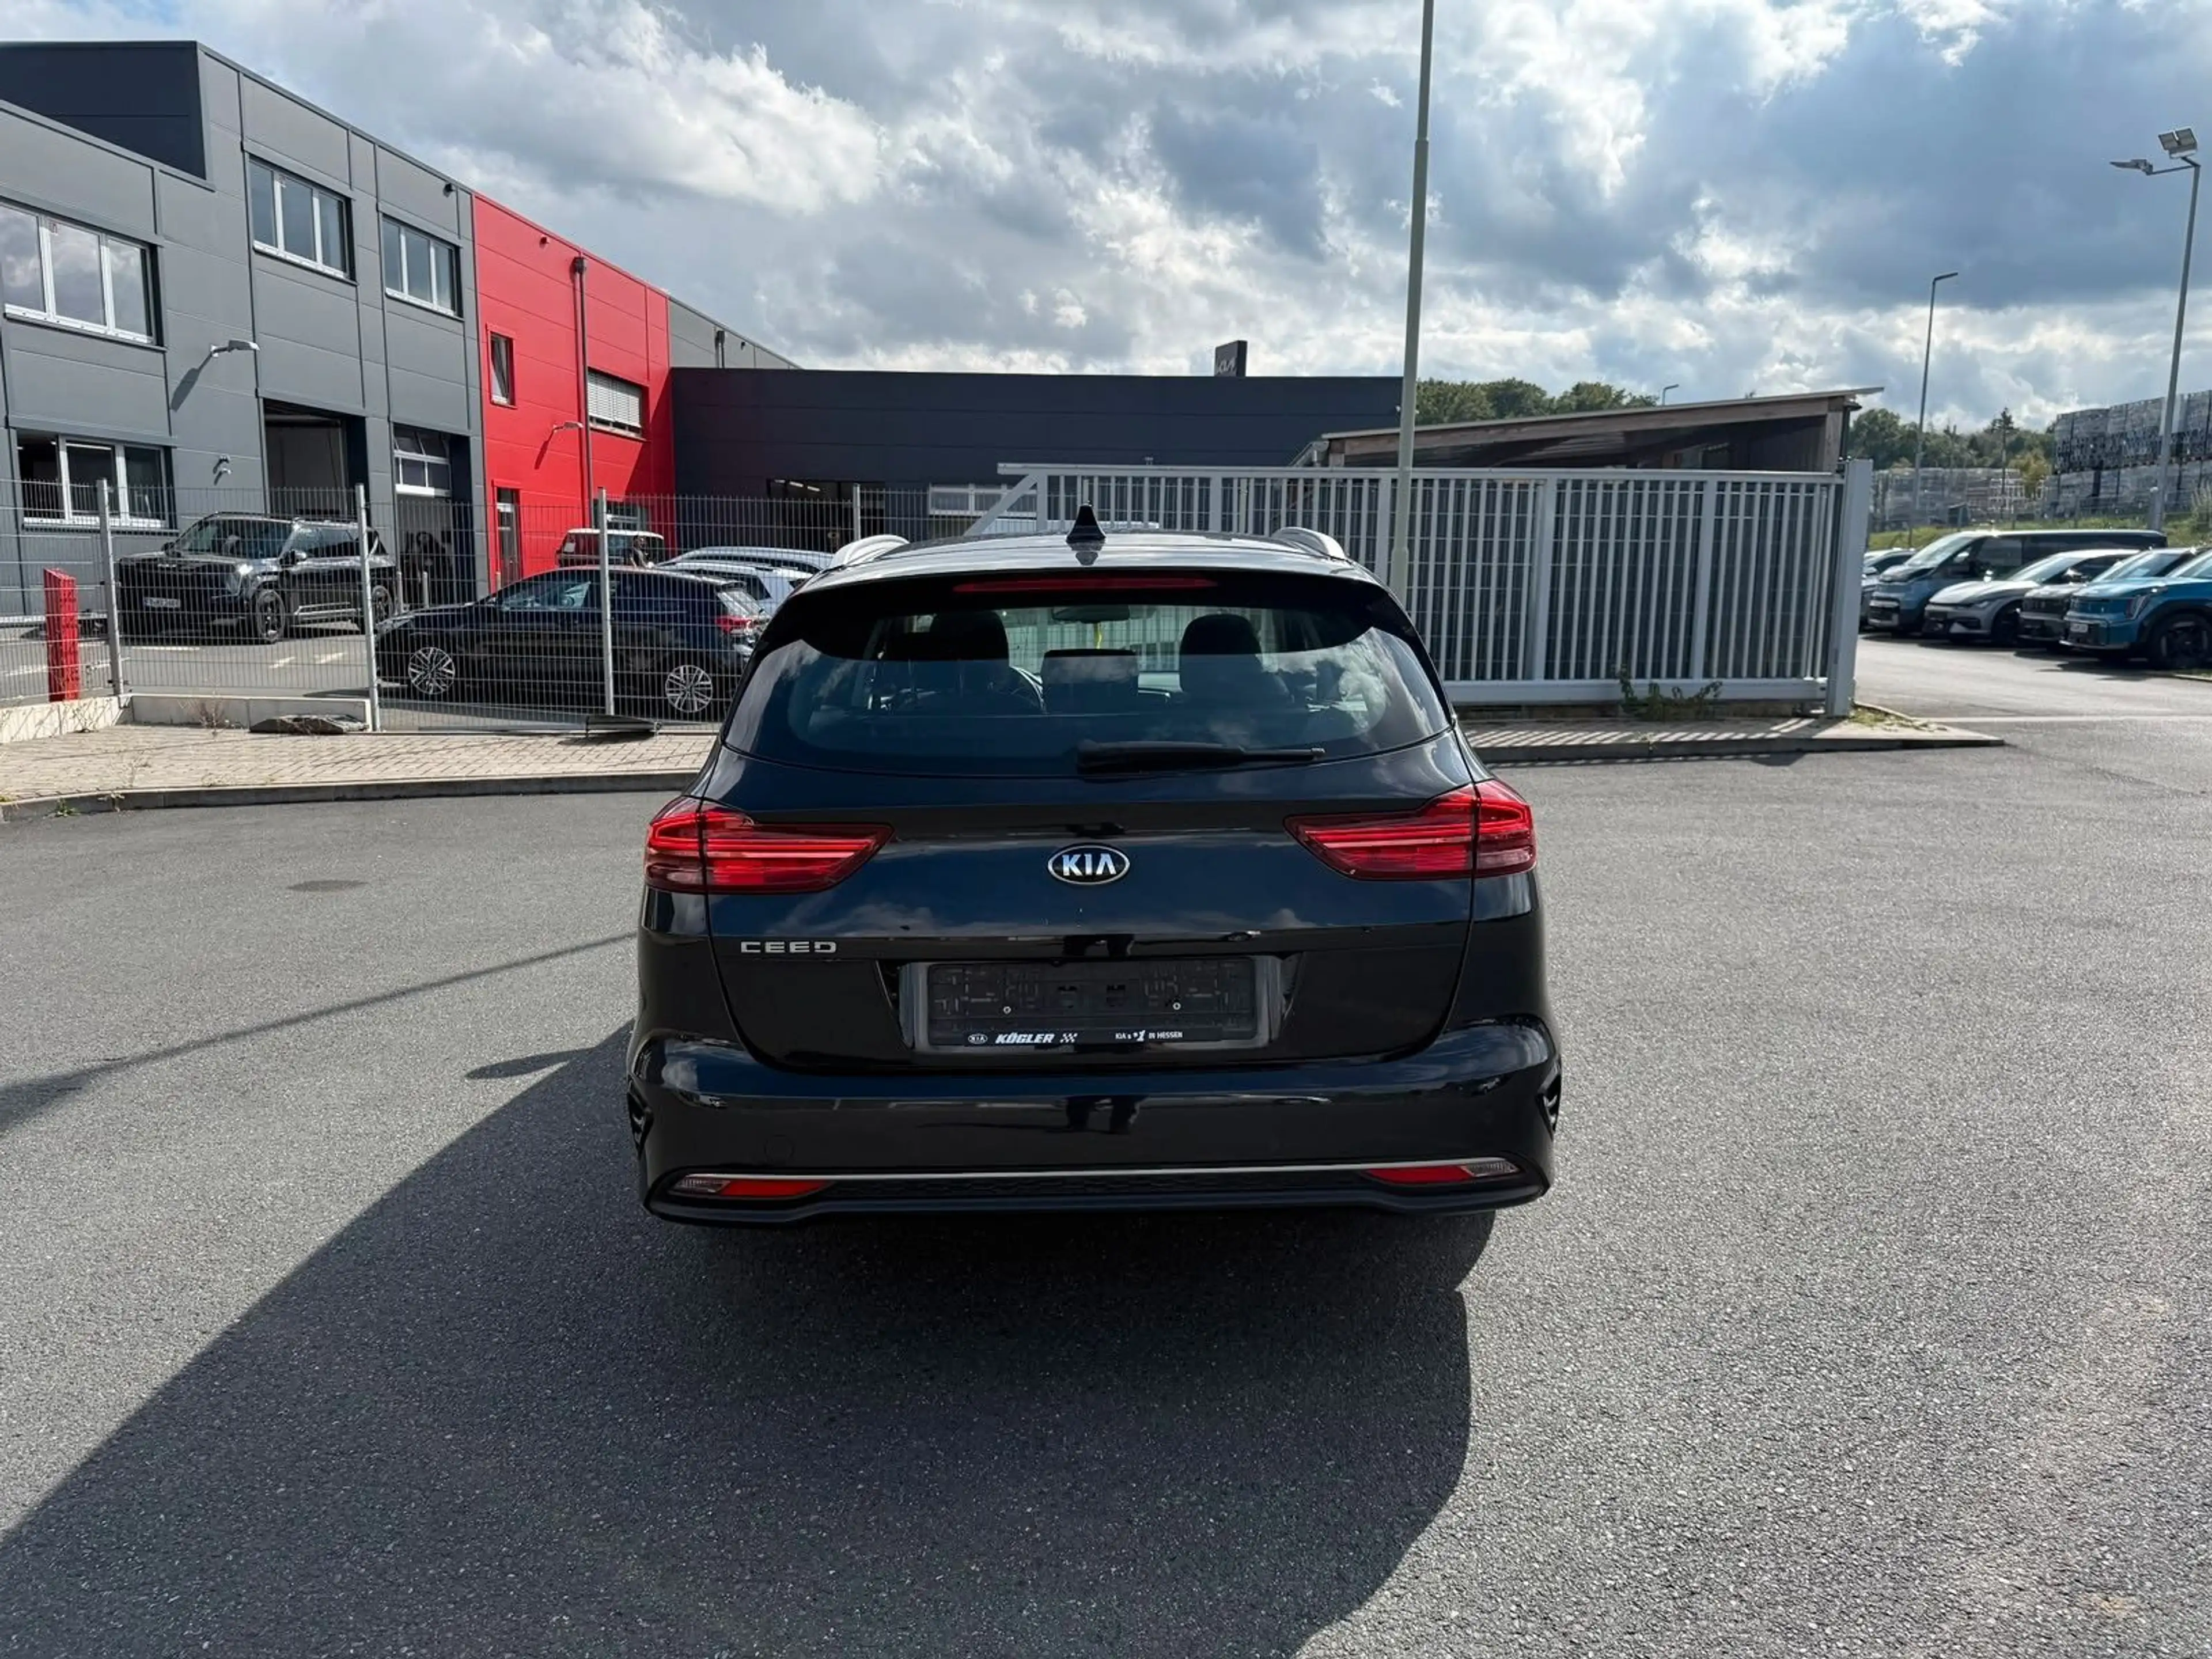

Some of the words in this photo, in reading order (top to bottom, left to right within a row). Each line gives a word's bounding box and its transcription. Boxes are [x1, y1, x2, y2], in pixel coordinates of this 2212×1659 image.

[1062, 853, 1117, 876] KIA
[741, 941, 837, 953] CEED
[995, 1032, 1055, 1044] KÖGLER
[1157, 1031, 1183, 1040] HESSEN
